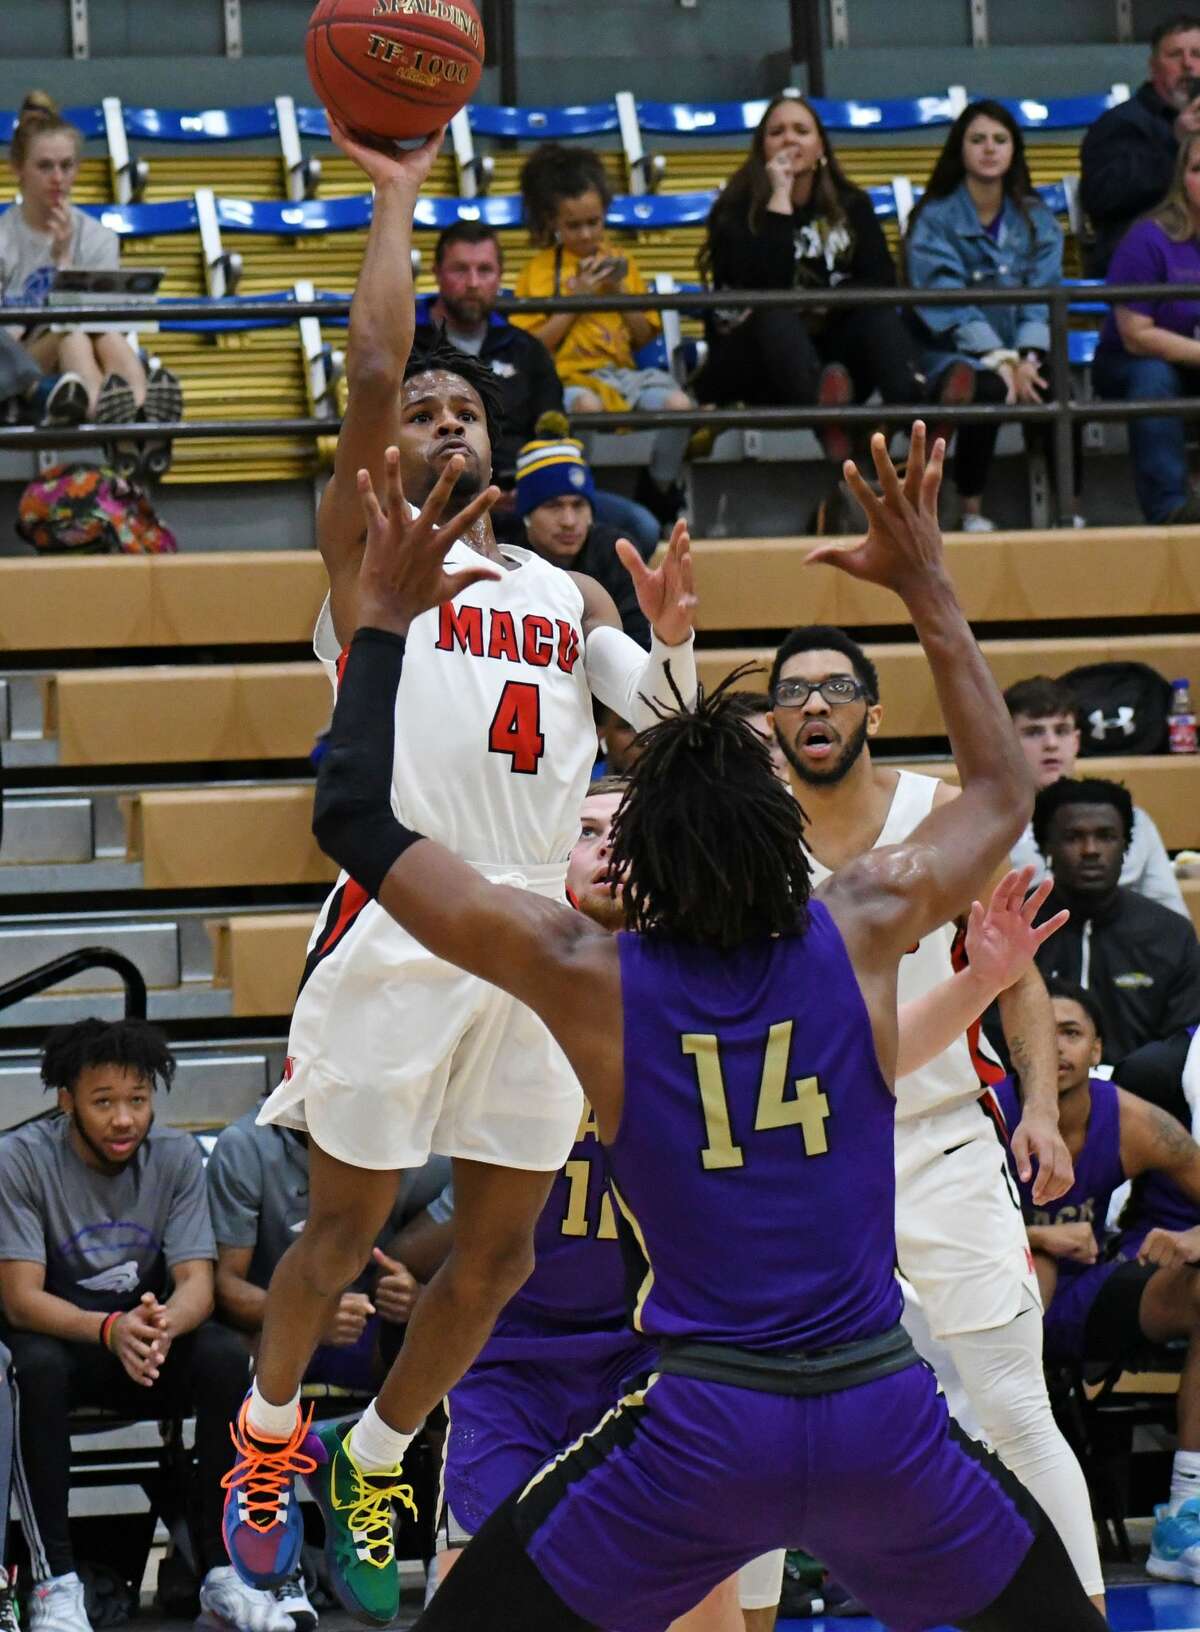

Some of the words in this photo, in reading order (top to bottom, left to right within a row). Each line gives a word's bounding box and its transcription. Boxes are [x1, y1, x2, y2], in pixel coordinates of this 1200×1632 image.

[435, 600, 579, 675] MACU
[488, 680, 545, 775] 4
[677, 1019, 831, 1170] 14
